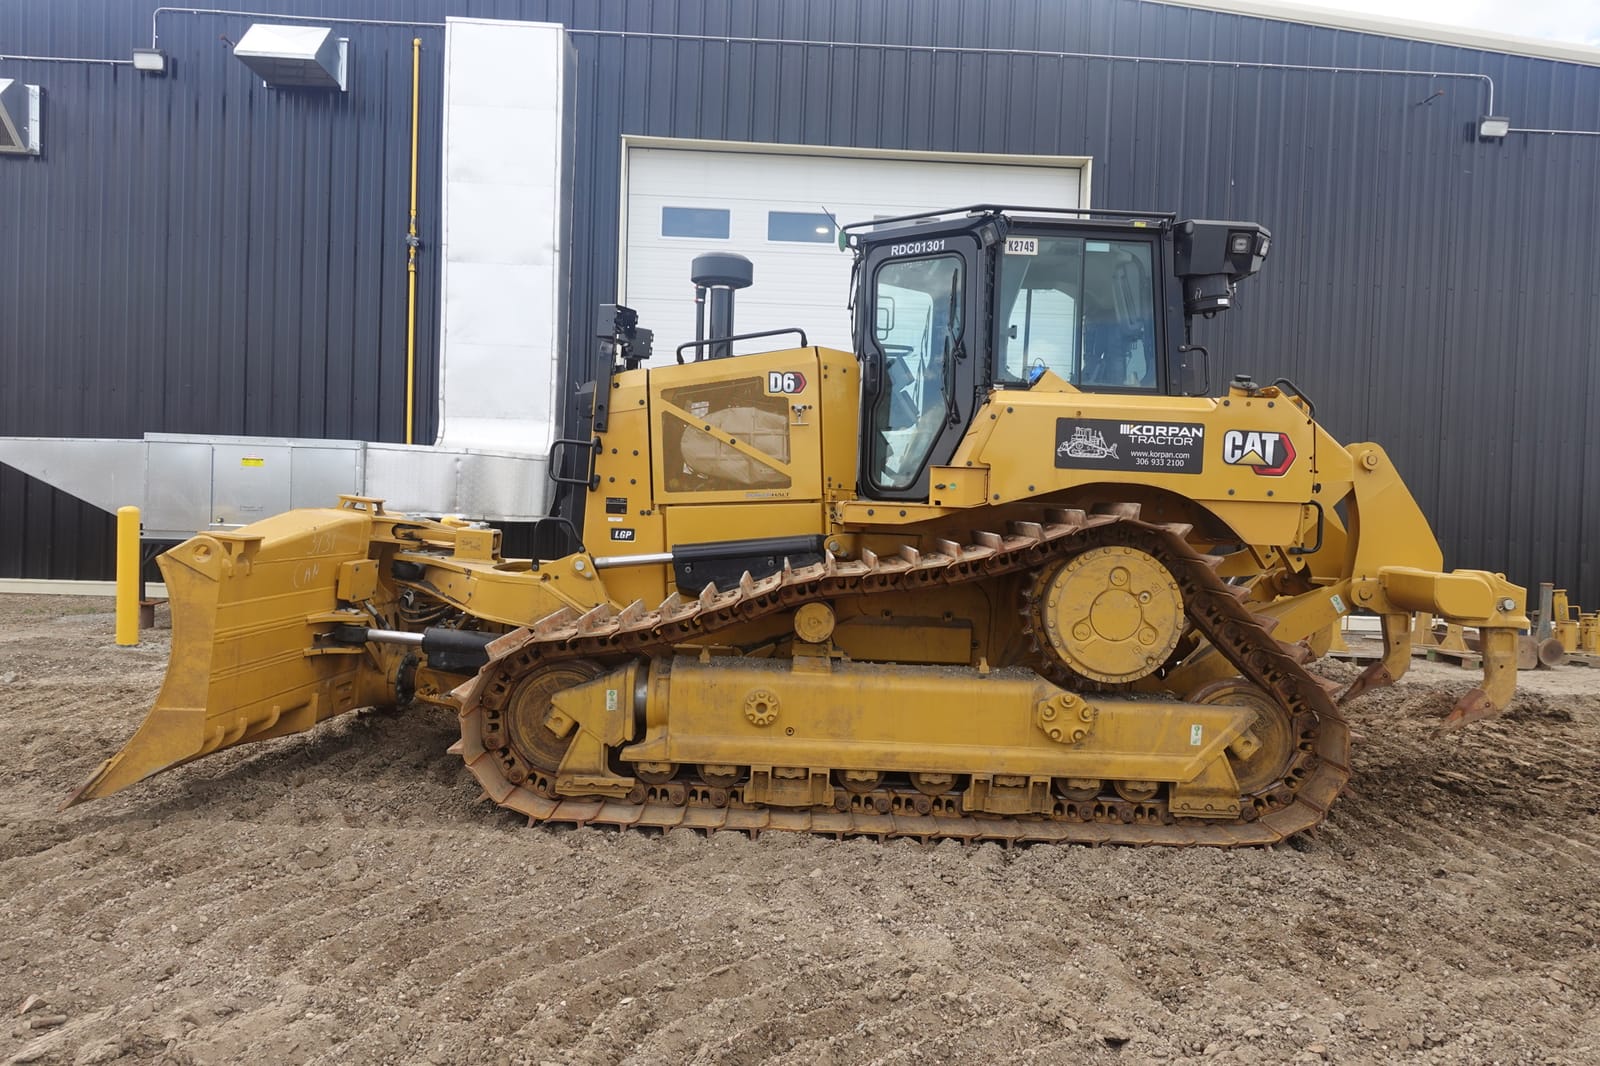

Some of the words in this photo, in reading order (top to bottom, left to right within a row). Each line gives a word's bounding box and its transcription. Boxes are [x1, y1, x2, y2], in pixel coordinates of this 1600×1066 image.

[891, 240, 945, 256] RDC01301
[1008, 240, 1035, 253] K2749
[769, 372, 795, 393] D6
[1128, 424, 1204, 438] KORPAN
[1128, 434, 1194, 446] TRACTOR
[1130, 449, 1191, 460] www.korpan.com
[1223, 430, 1280, 466] CAT
[1135, 457, 1150, 466] 306
[1151, 458, 1165, 467] 933
[1166, 458, 1185, 467] 2100
[614, 530, 632, 540] LGP
